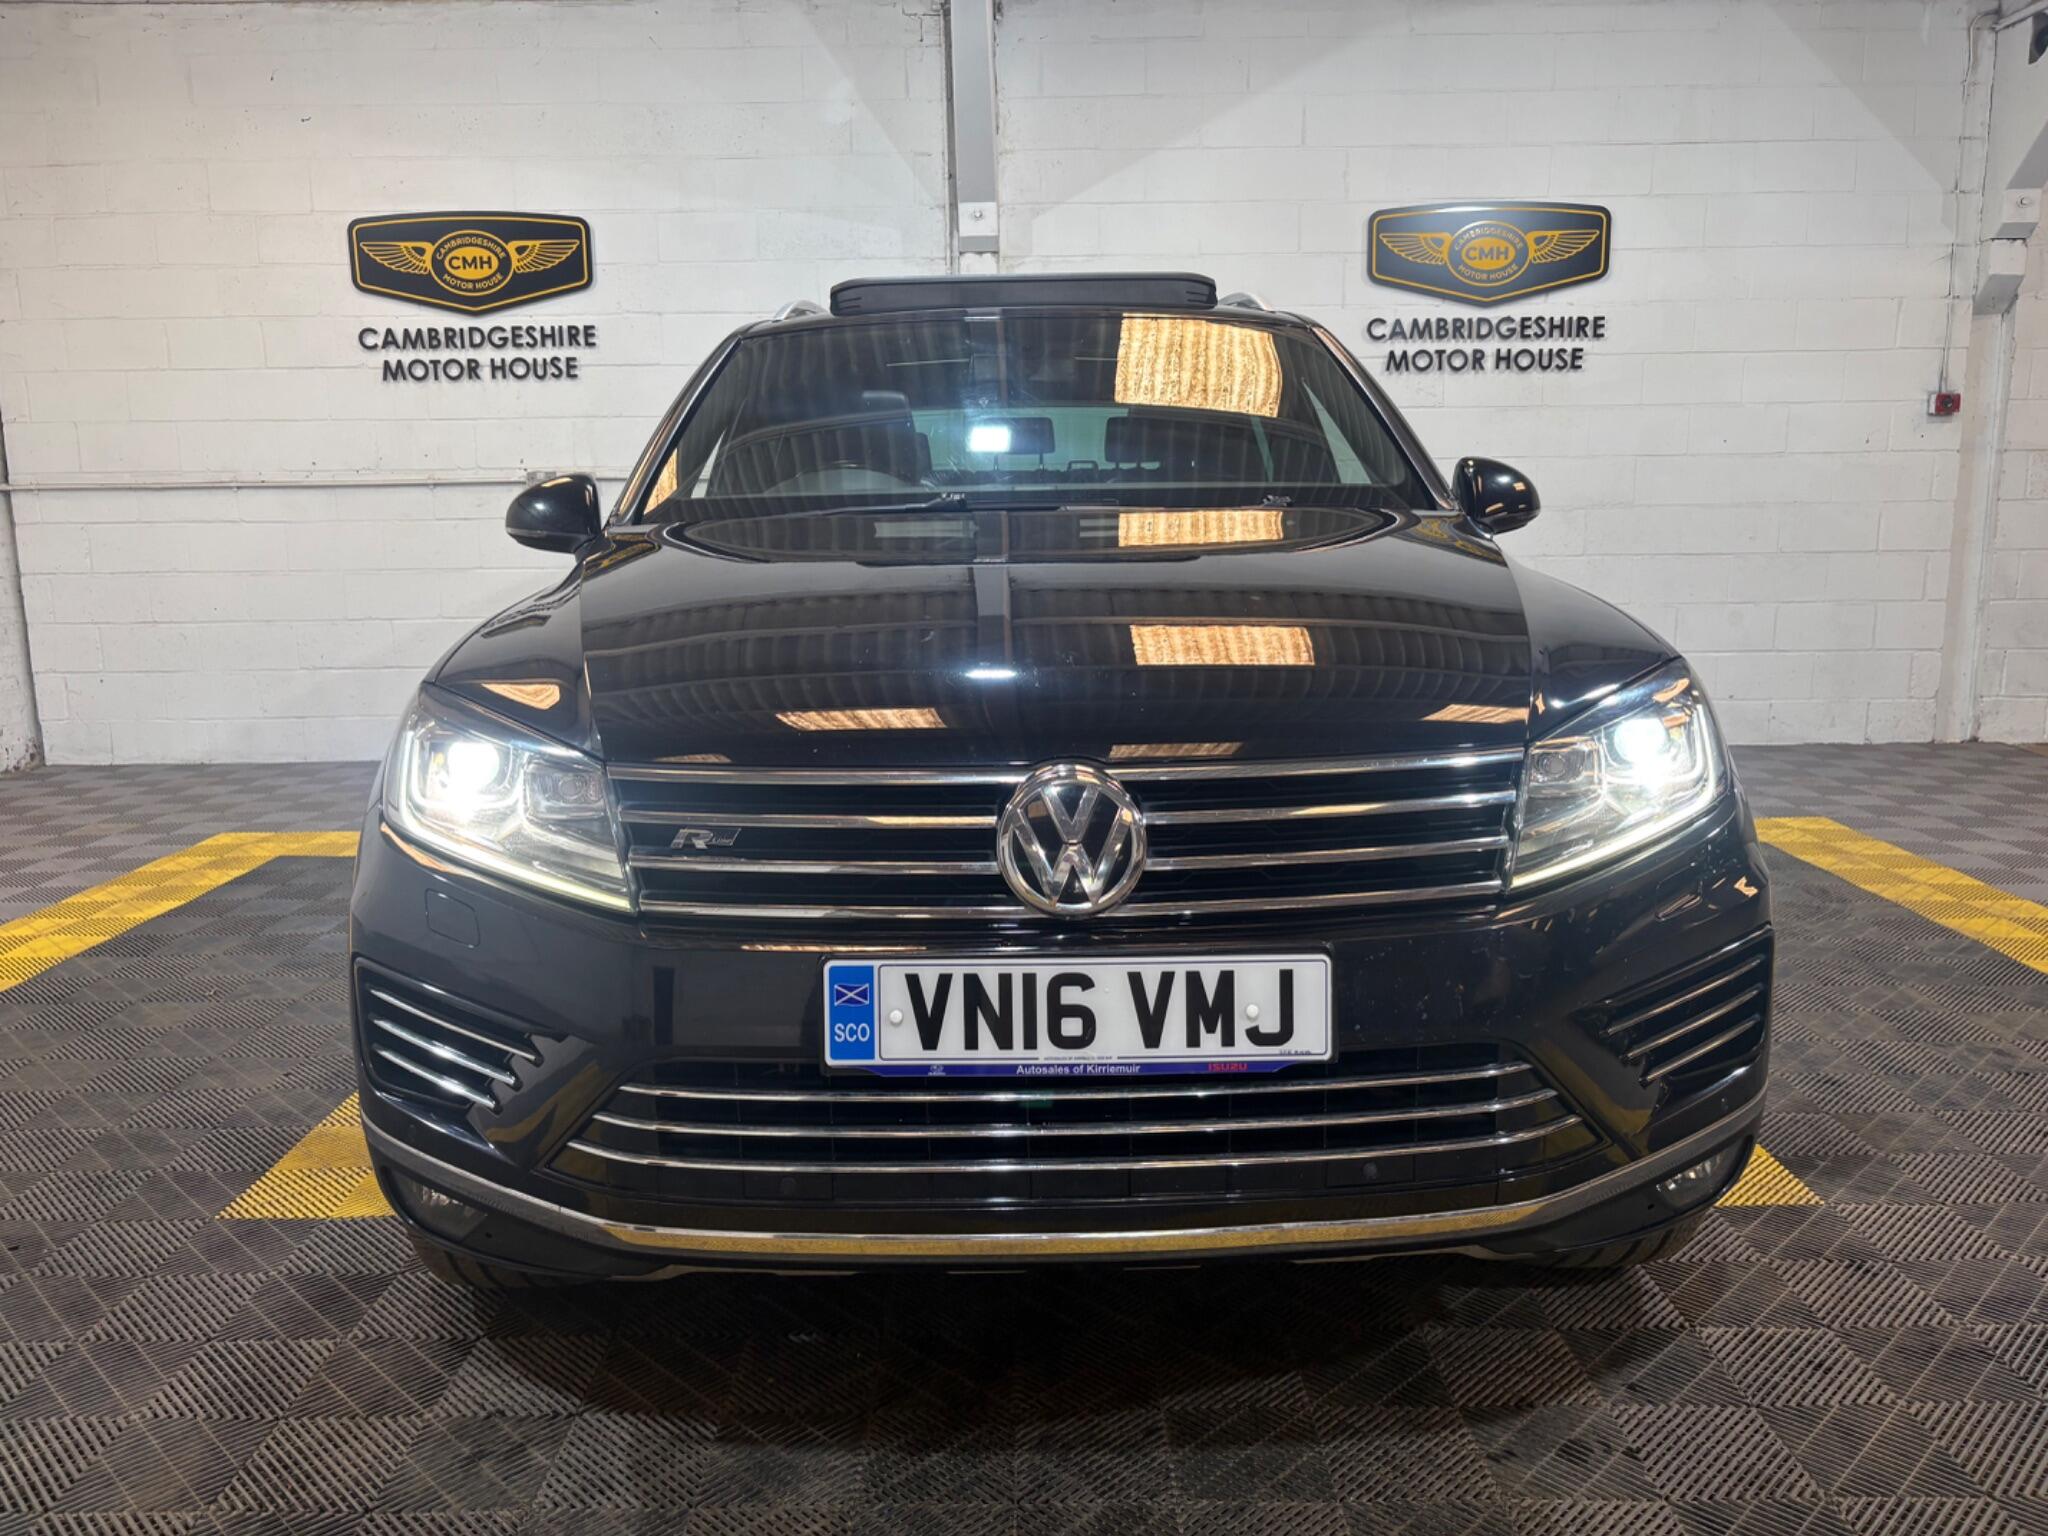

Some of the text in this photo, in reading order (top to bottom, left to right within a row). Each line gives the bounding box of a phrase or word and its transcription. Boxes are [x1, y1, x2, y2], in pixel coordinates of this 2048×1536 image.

[436, 236, 507, 260] CAMBRIDGESHIRE
[1465, 246, 1510, 260] CMH
[448, 255, 493, 270] CMH
[1458, 263, 1519, 280] MOTOR HOUSE
[442, 271, 503, 290] MOTOR HOUSE
[358, 324, 597, 350] CAMBRIDGESHIRE
[1366, 315, 1606, 341] CAMBRIDGESHIRE
[382, 356, 578, 382] MOTOR HOUSE
[1385, 347, 1584, 372] MOTOR HOUSE
[904, 968, 1294, 1051] VN16 VMJ
[833, 1022, 871, 1043] SCO
[1016, 1063, 1141, 1075] Autosales of Kirriemuir
[1207, 1062, 1248, 1073] ISUZU
